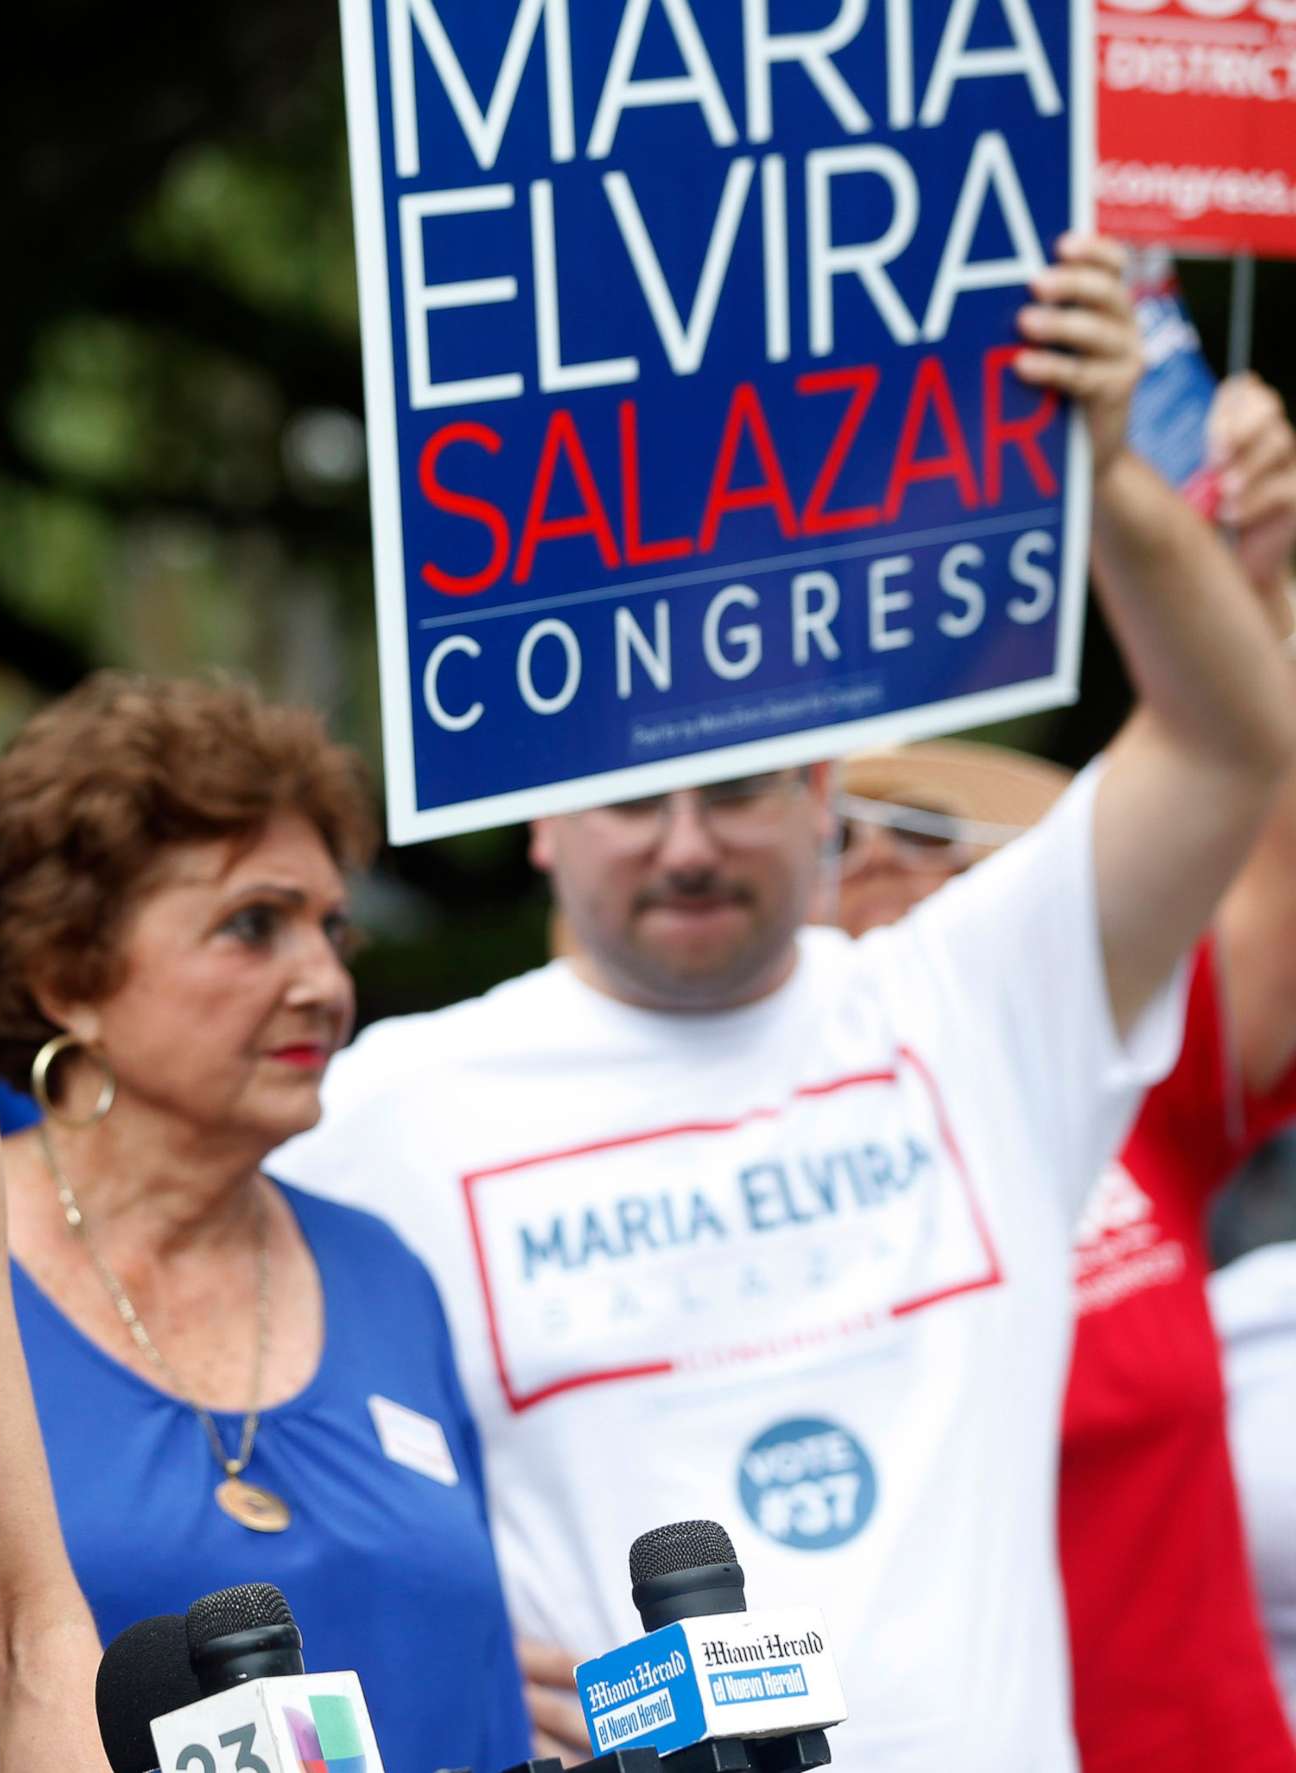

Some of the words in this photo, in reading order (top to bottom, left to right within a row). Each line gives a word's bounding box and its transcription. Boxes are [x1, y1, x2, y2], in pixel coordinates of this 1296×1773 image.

[386, 0, 1064, 178] MARIA
[399, 131, 1054, 410] ELVIRA
[418, 345, 1059, 597] SALAZAR
[423, 531, 1056, 732] CONGRESS
[518, 1186, 728, 1283] MARIA
[738, 1136, 932, 1232] ELVIRA
[745, 1431, 856, 1486] VOTE
[587, 1670, 638, 1712] Miami
[635, 1650, 687, 1691] Herald
[702, 1636, 766, 1667] Miami
[766, 1631, 824, 1660] Herald
[713, 1672, 726, 1697] el
[726, 1674, 763, 1700] Nuevo
[765, 1668, 804, 1695] Herald
[598, 1721, 609, 1746] el
[607, 1705, 639, 1739] Nuevo
[637, 1697, 672, 1729] Herald
